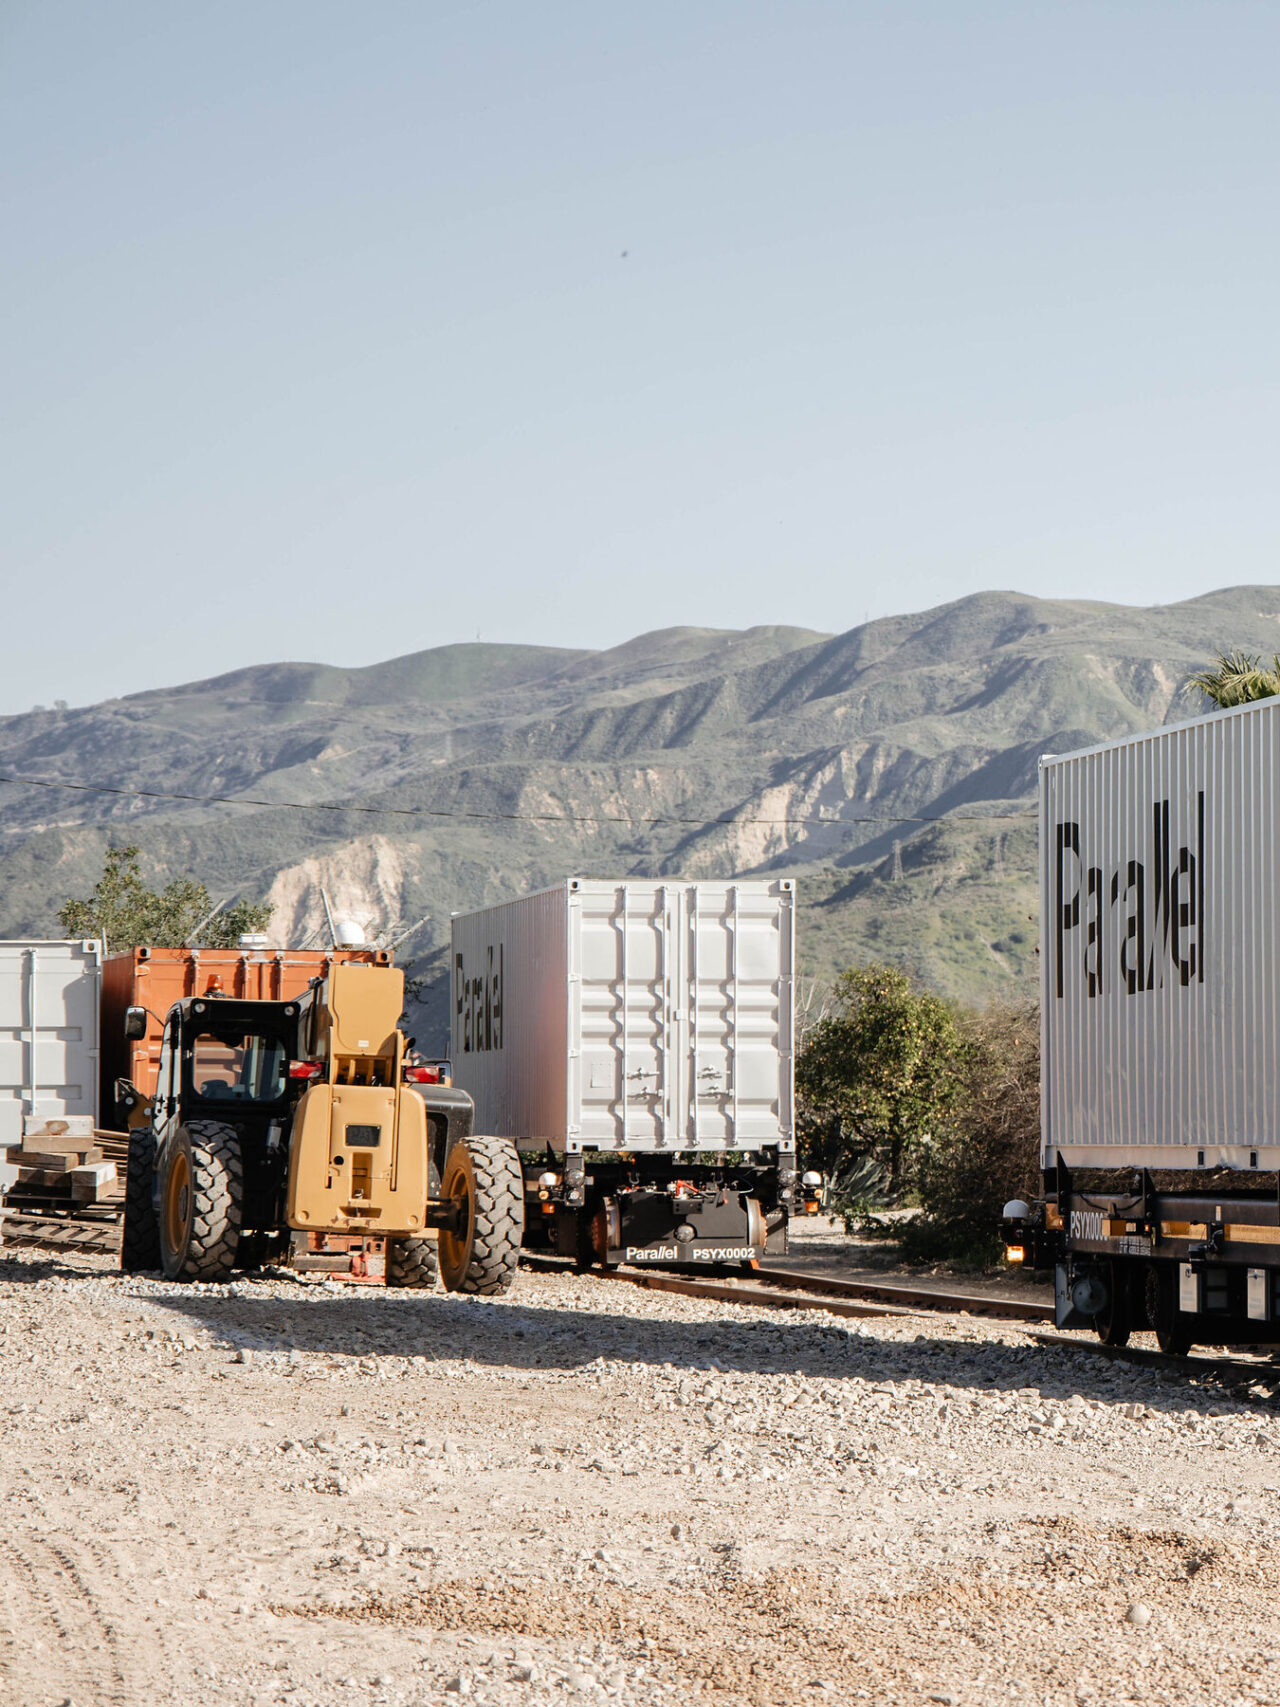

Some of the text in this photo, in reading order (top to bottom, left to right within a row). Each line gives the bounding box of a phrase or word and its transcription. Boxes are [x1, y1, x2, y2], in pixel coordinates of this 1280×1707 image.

[1057, 791, 1204, 998] Parallel
[1070, 1211, 1109, 1241] PSYX000
[626, 1246, 755, 1261] Parallel PSYX0002
